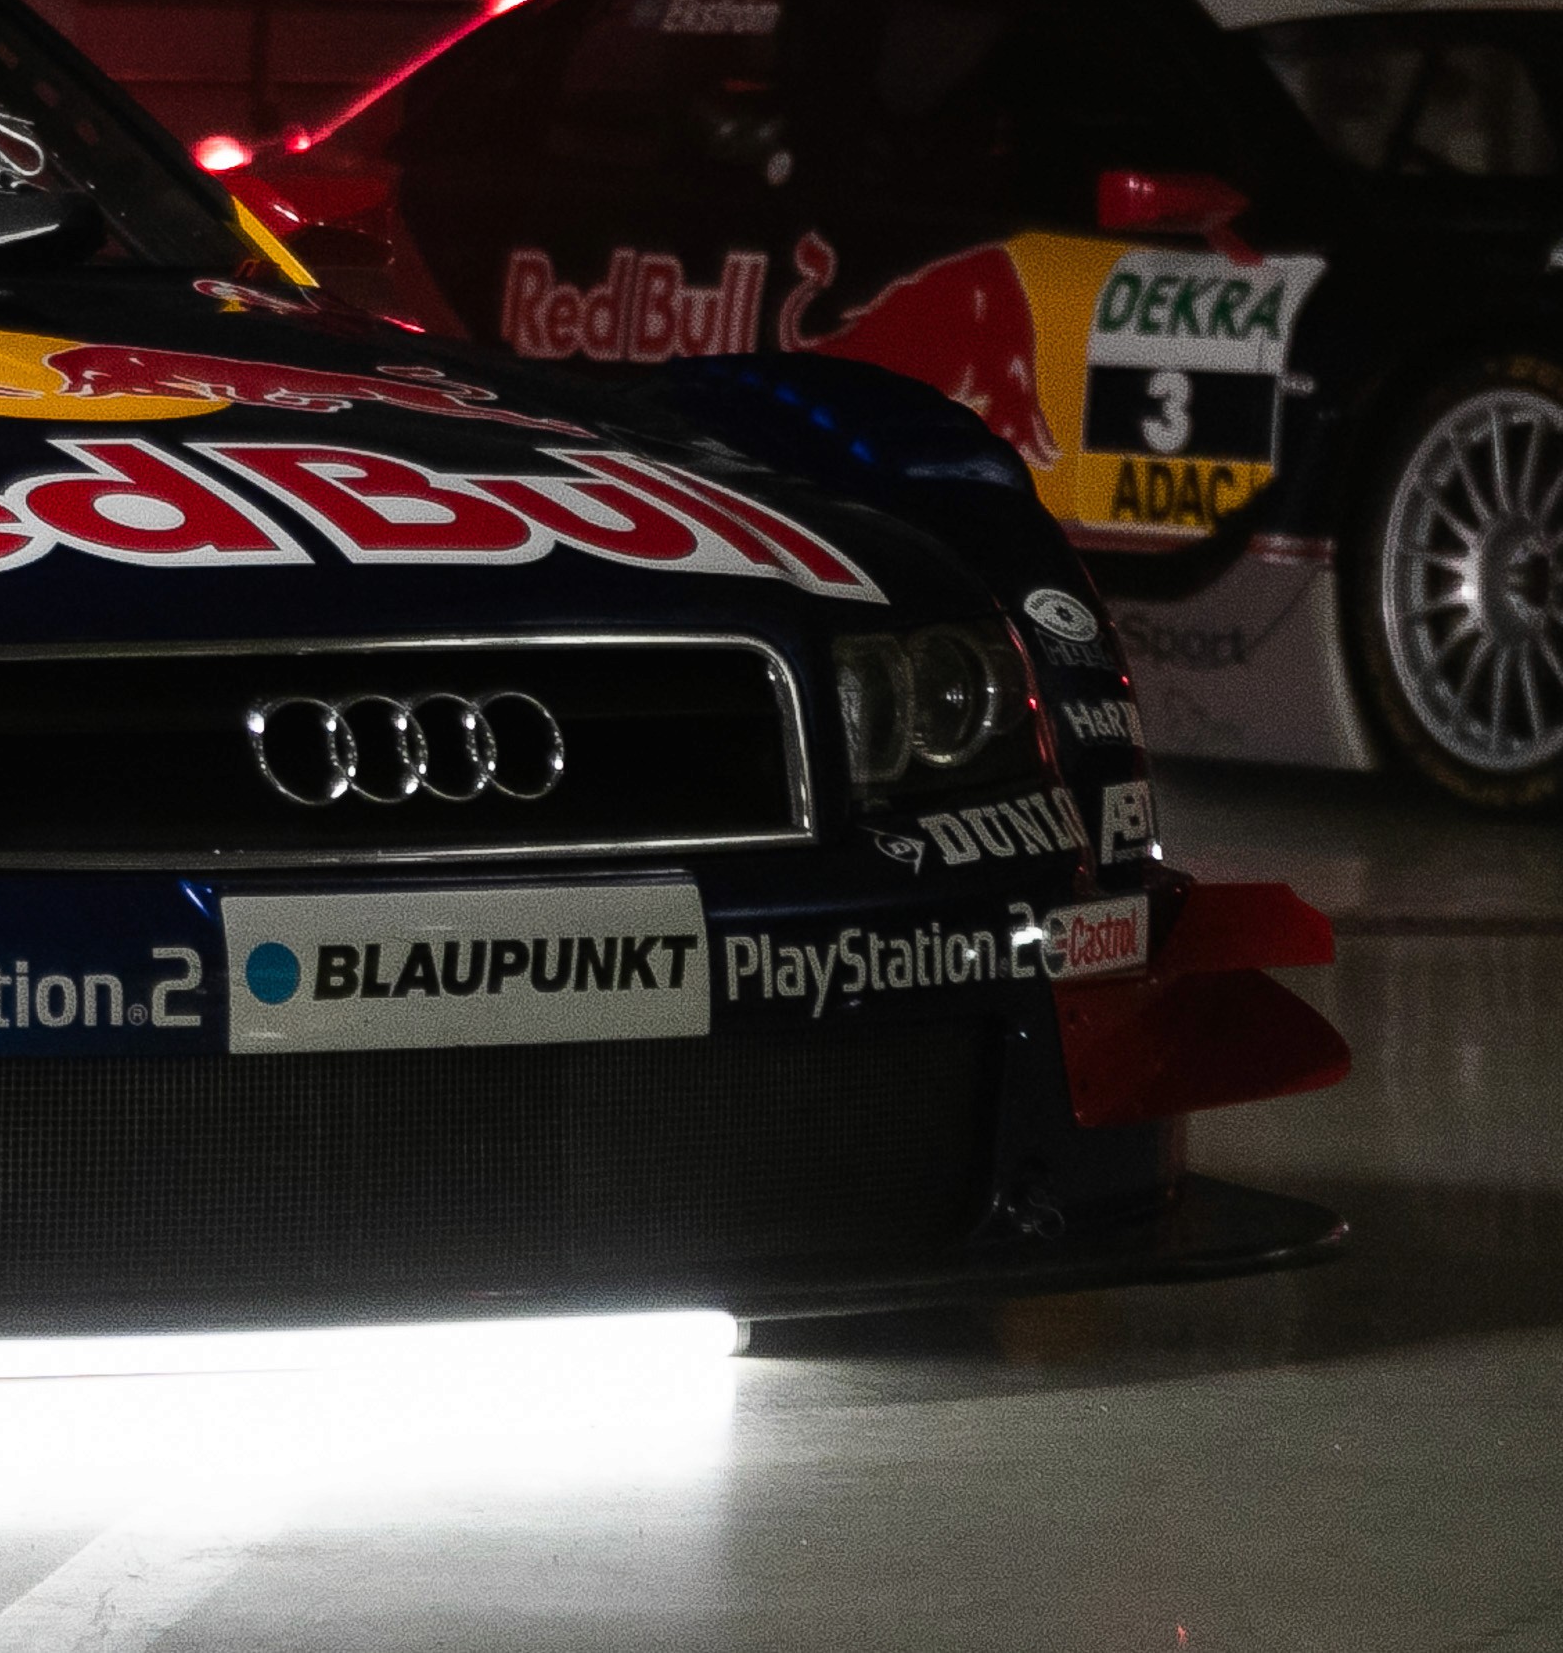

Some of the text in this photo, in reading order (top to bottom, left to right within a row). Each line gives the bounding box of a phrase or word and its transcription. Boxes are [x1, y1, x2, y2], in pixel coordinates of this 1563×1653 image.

[1097, 272, 1286, 341] DEKRA
[1141, 370, 1193, 453] 3
[184, 443, 891, 605] Bull
[1111, 460, 1235, 524] ADAC
[312, 934, 699, 1002] BLAUPUNKT
[1070, 908, 1138, 967] Castrol
